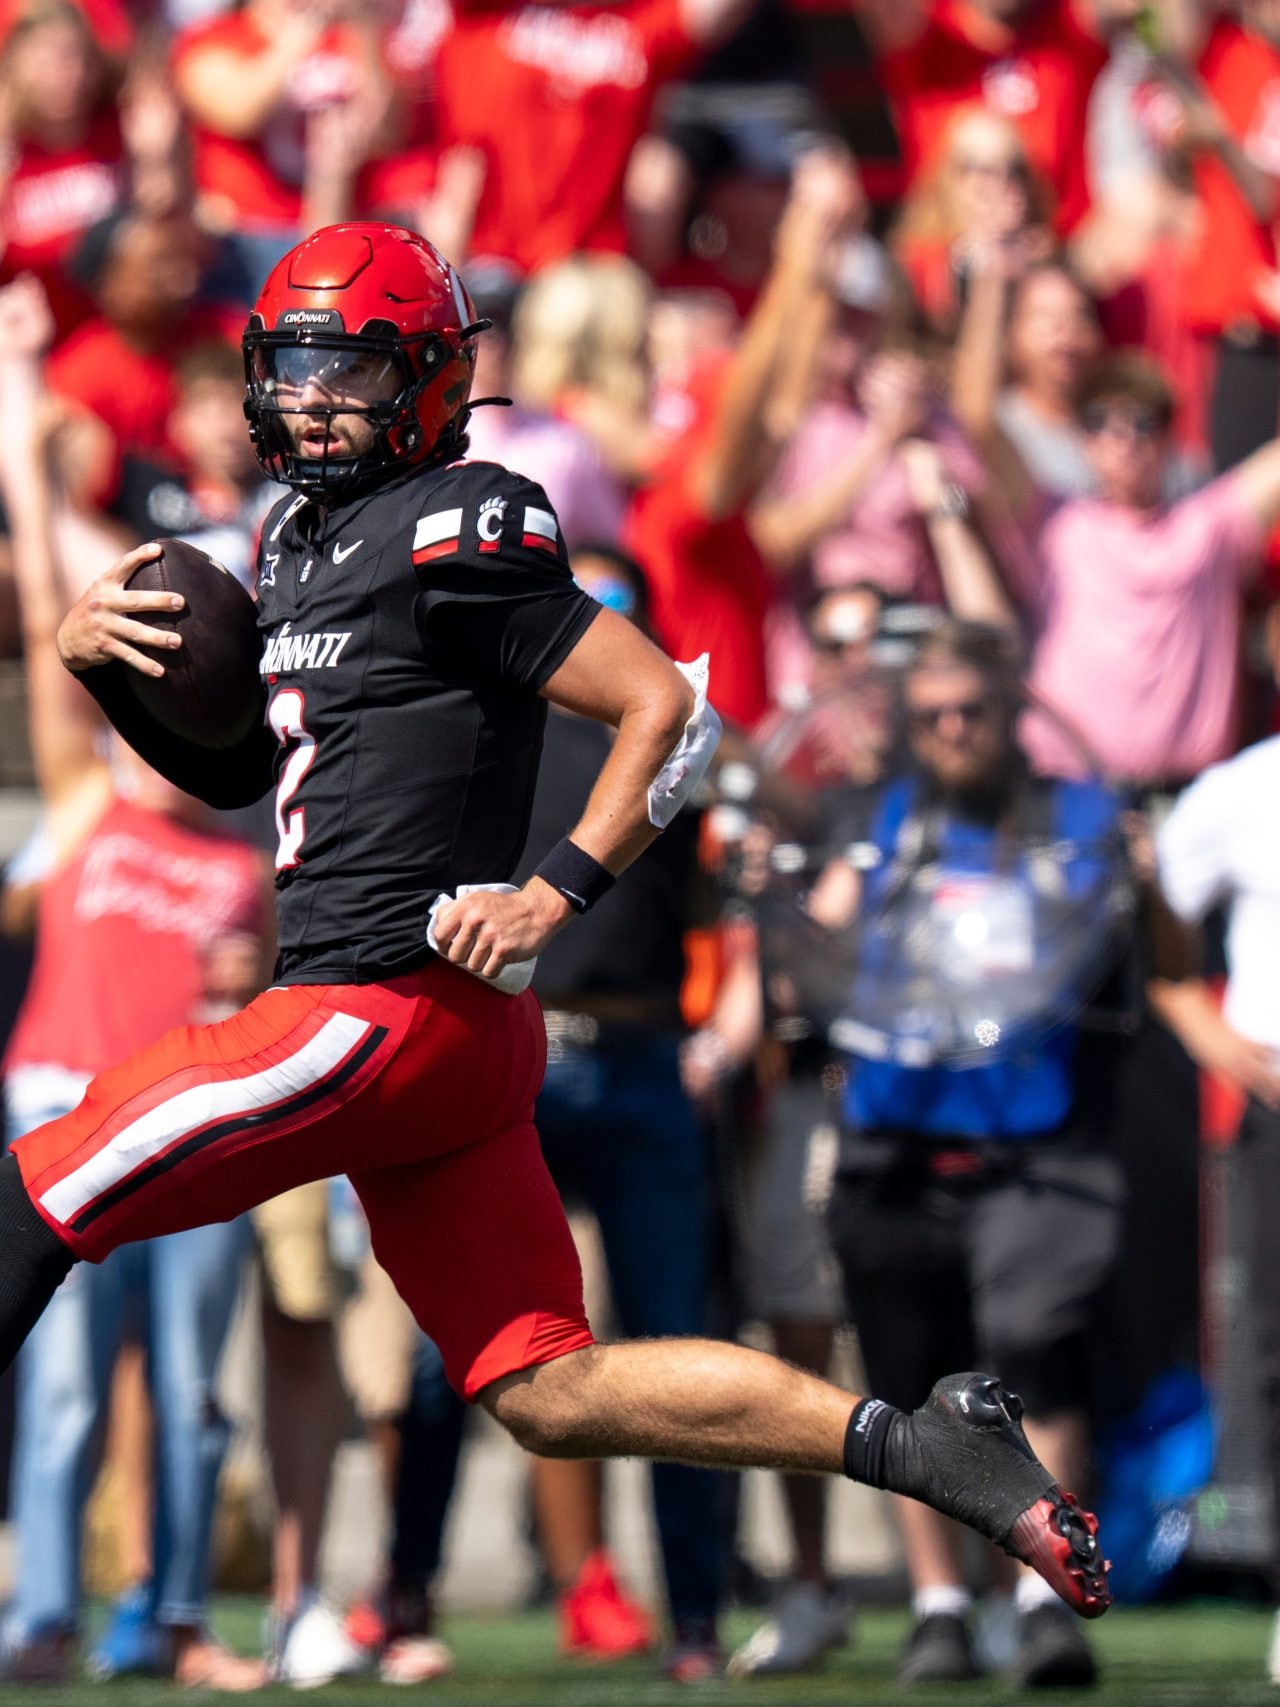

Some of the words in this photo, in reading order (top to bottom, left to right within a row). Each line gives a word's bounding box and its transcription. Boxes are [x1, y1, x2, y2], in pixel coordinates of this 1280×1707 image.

[284, 311, 331, 325] CINCINNATI
[269, 688, 318, 869] 2
[855, 1399, 886, 1433] NIKE
